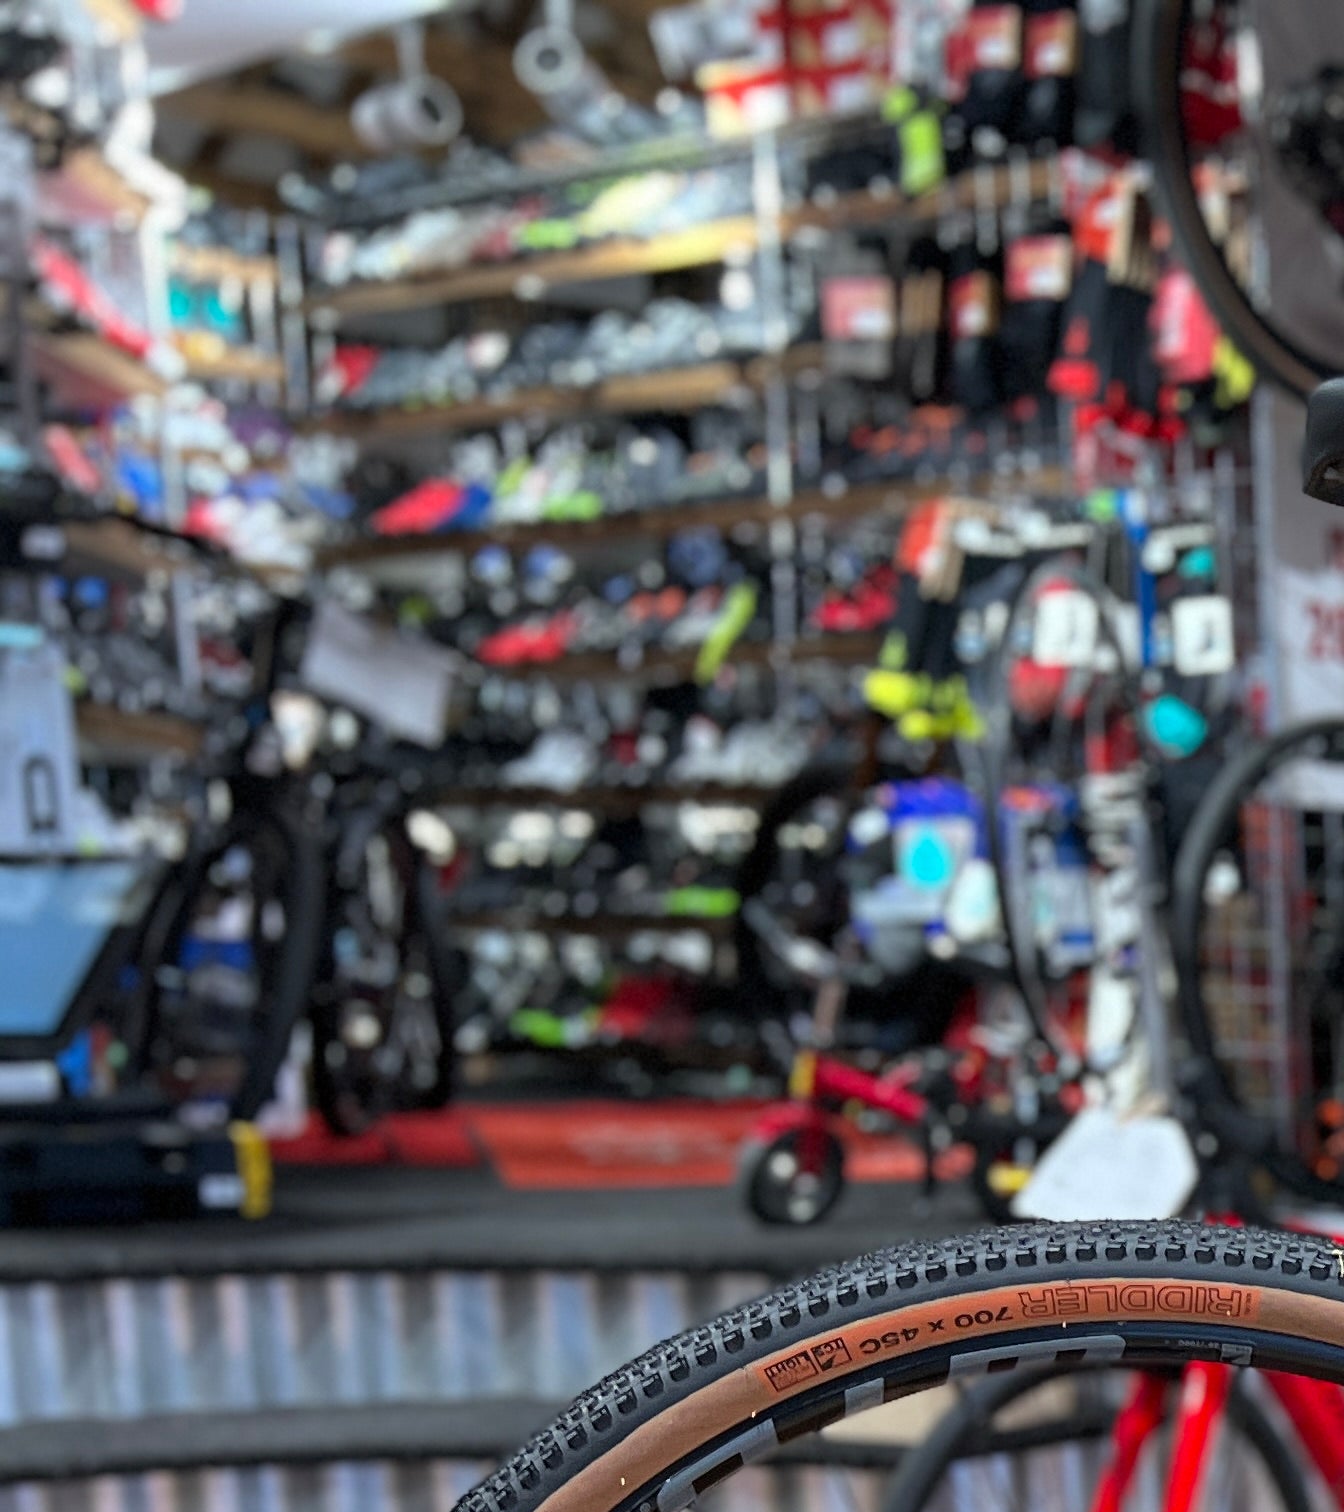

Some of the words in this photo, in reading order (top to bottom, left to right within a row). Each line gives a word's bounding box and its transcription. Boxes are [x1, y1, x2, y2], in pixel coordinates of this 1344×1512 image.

[1020, 1285, 1245, 1320] RIDDLER
[953, 1306, 1014, 1330] 700
[858, 1326, 919, 1355] 45C
